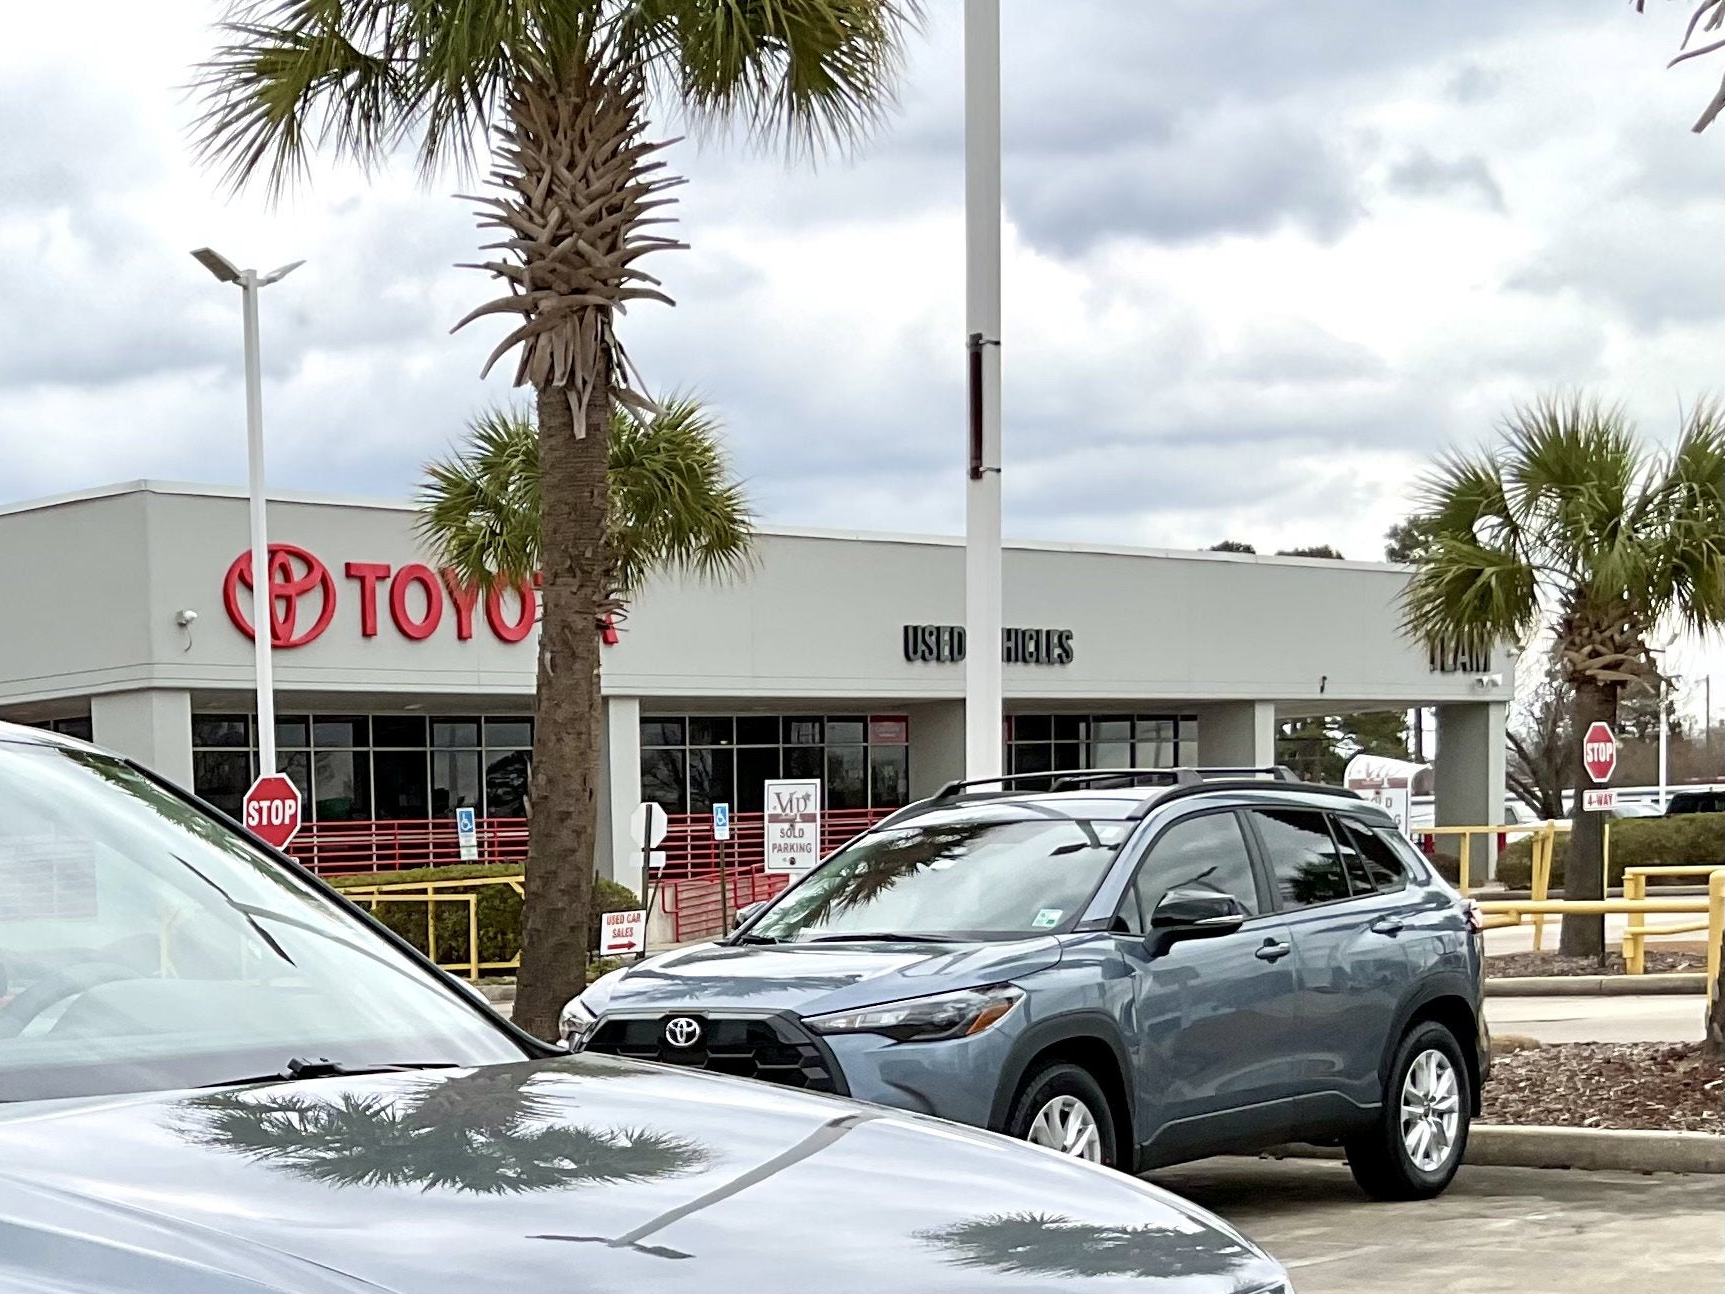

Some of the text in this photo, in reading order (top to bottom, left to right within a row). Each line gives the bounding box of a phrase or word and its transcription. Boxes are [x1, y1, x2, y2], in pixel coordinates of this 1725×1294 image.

[345, 562, 619, 644] TOYO
[903, 625, 1074, 664] USED HICLES
[1586, 742, 1613, 763] STOP
[1587, 794, 1613, 806] 4-WAY
[248, 799, 296, 826] STOP
[779, 828, 805, 838] SOLD
[772, 843, 812, 853] PARKING
[607, 912, 641, 925] USED CAR
[612, 927, 634, 938] SALES
